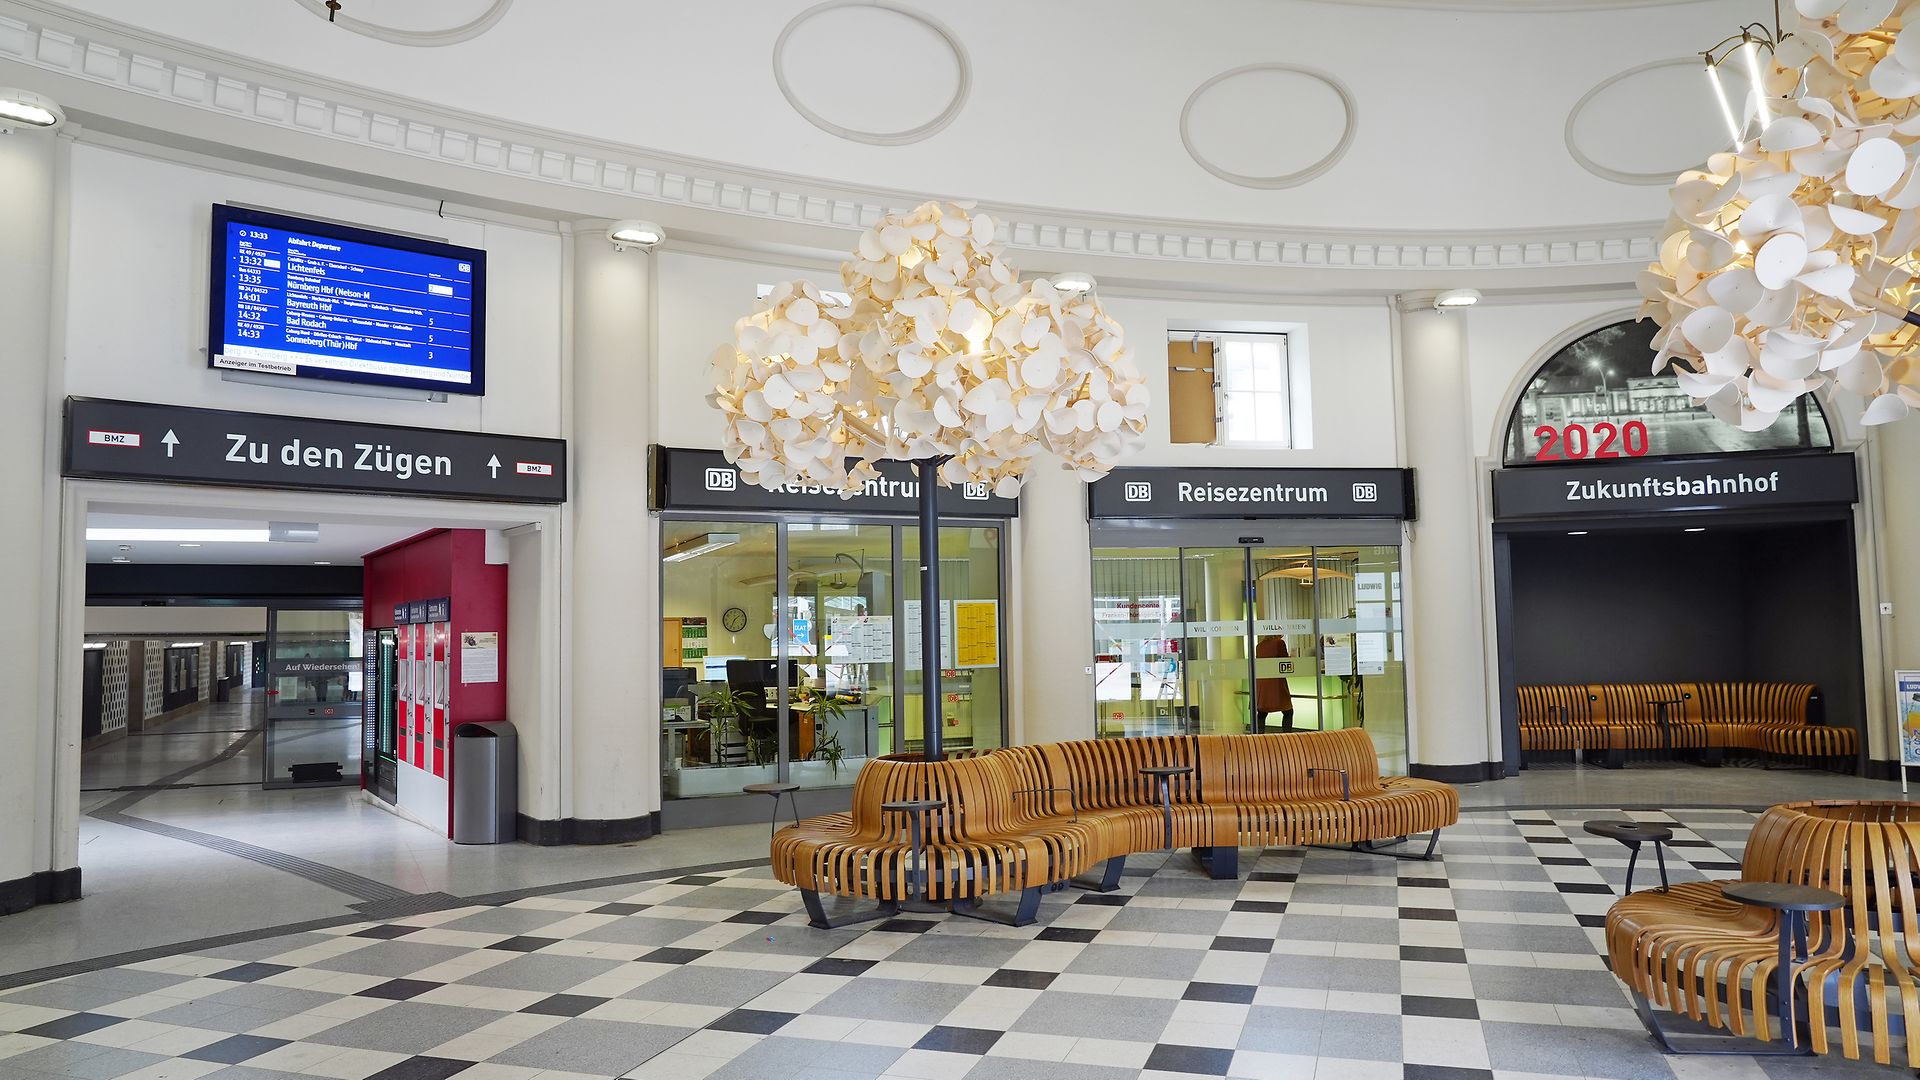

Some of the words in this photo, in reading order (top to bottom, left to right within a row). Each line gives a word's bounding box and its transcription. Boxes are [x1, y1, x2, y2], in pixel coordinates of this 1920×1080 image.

[250, 231, 267, 240] 13:33
[240, 256, 262, 266] 13:32
[288, 263, 325, 275] Lichtenfels
[240, 274, 261, 284] 13:35
[287, 282, 320, 294] Nürnberg
[321, 286, 334, 294] Hbf
[335, 286, 370, 299] (Nelson-M
[239, 292, 260, 302] 14:01
[287, 299, 318, 310] Bayreuth
[320, 303, 332, 311] Hbf
[238, 310, 261, 320] 14:32
[286, 317, 300, 326] Bad
[302, 318, 326, 328] Rodach
[238, 329, 260, 338] 14:33
[220, 358, 248, 367] Anzeiger
[258, 362, 291, 371] Testbetrieb
[1533, 420, 1648, 461] 2020
[104, 434, 125, 443] BMZ
[225, 433, 269, 464] Zu
[281, 438, 343, 469] den
[354, 444, 452, 480] Zügen
[708, 471, 735, 489] DB
[768, 476, 920, 498] esentru
[965, 482, 987, 498] DB
[1566, 471, 1779, 501] Zukunftsbahnhof
[1127, 484, 1150, 500] DB
[1178, 482, 1328, 502] Reisezentrum
[1354, 484, 1375, 500] DB
[1280, 663, 1293, 672] DB
